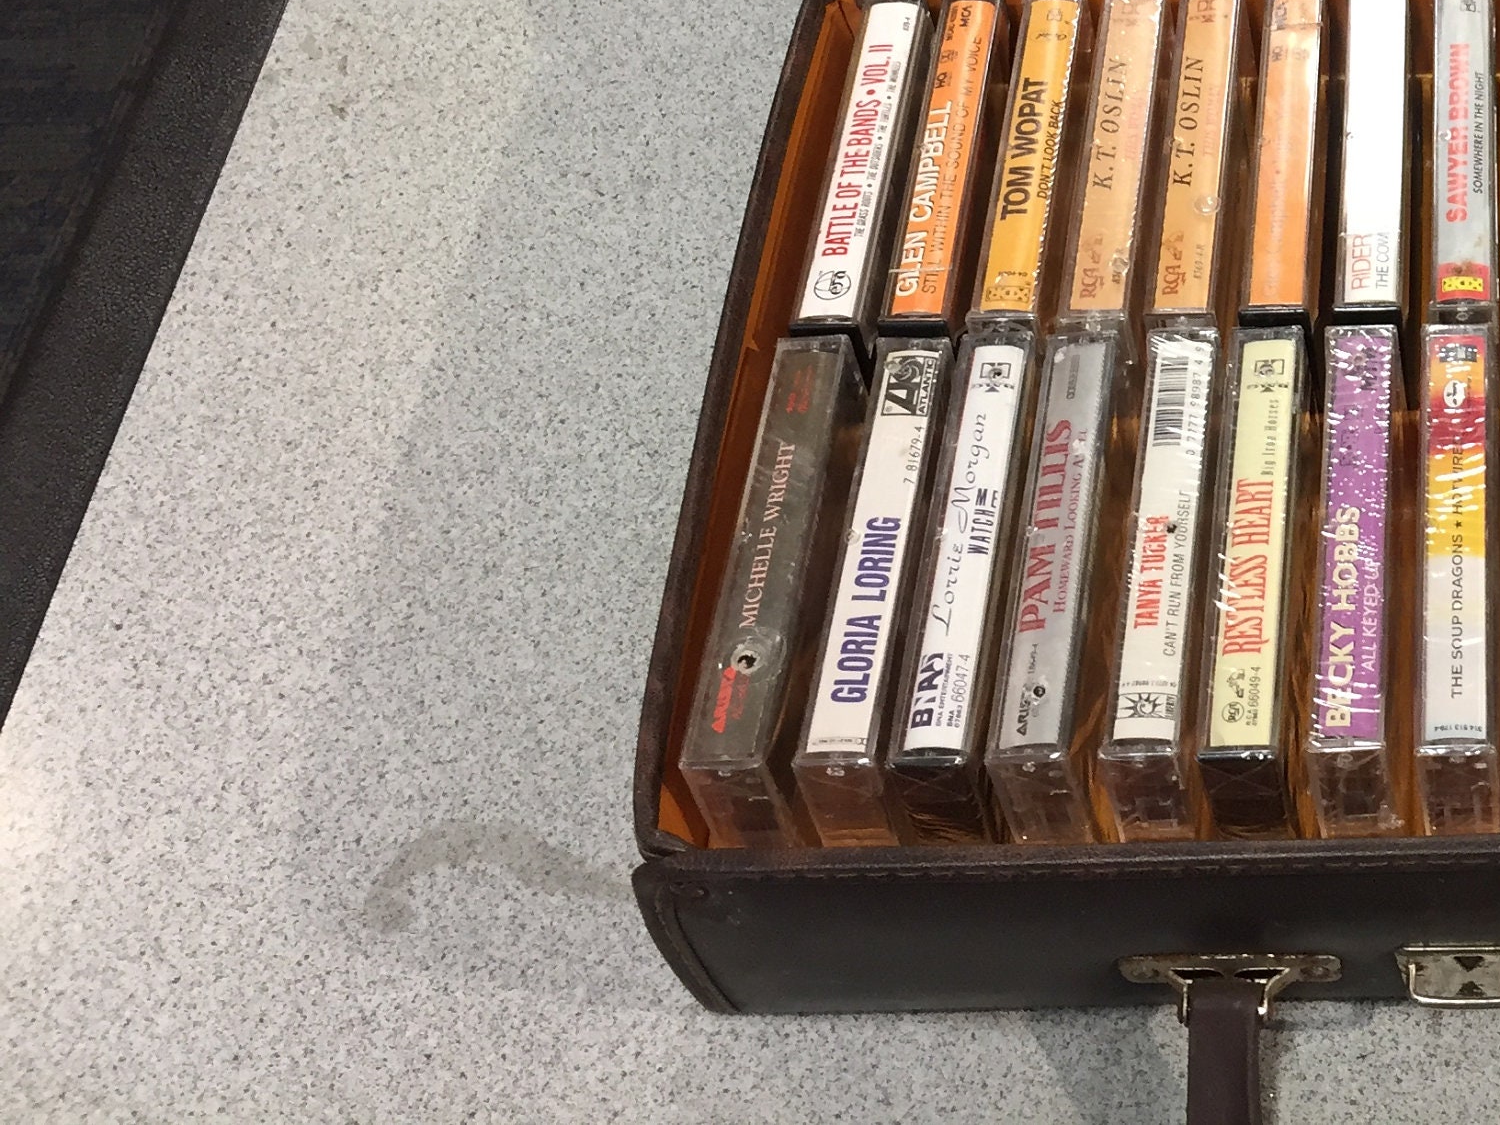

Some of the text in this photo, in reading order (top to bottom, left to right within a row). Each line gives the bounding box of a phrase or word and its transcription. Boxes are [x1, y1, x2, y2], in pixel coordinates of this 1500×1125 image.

[959, 6, 972, 27] MCA
[1010, 77, 1049, 159] WOPAT
[1099, 58, 1128, 134] OSLIN
[1178, 56, 1204, 130] OSLIN
[821, 44, 893, 257] BATTLE OF THE BANDS VOL. II
[928, 37, 982, 252] WITHIN THE SOUND OF MY VOICE
[1036, 100, 1062, 199] DON'T LOOK BACK
[1446, 43, 1470, 222] SAWYER BROWN
[1472, 72, 1485, 194] SOMEWHERE IN THE NIGHT
[895, 100, 953, 296] GLEN CAMPBELL
[1000, 166, 1035, 221] TOM
[1079, 268, 1104, 298] RCA
[1162, 265, 1186, 295] RCA
[1376, 266, 1389, 289] THE
[918, 359, 936, 414] ATLANTIC
[906, 426, 924, 471] 81679-4
[1260, 399, 1279, 476] Big Iron Horses
[739, 439, 796, 628] MICHELLE WRIGHT
[852, 516, 901, 602] LORING
[932, 414, 989, 637] Lorrie Morgan
[966, 509, 994, 555] WATCH
[1018, 419, 1073, 632] PAM TILLIS
[1133, 516, 1169, 629] TANYA TUCKER
[1167, 592, 1182, 616] RUN
[1170, 553, 1184, 587] FROM
[1222, 478, 1274, 656] RESTLESS HEART
[1450, 534, 1463, 611] DRAGONS
[1163, 621, 1178, 656] CAN'T
[1325, 506, 1361, 727] BECKY HOBBS
[1362, 558, 1380, 672] ALL KEYED UP
[1450, 615, 1463, 660] SOUP
[831, 615, 882, 702] GLORIA
[939, 653, 954, 709] ENTERTAINMENT
[950, 654, 970, 703] 66047-4
[1248, 666, 1260, 707] 66049-4
[1451, 665, 1463, 698] THE
[947, 710, 955, 727] BNA
[1228, 703, 1241, 722] RCA
